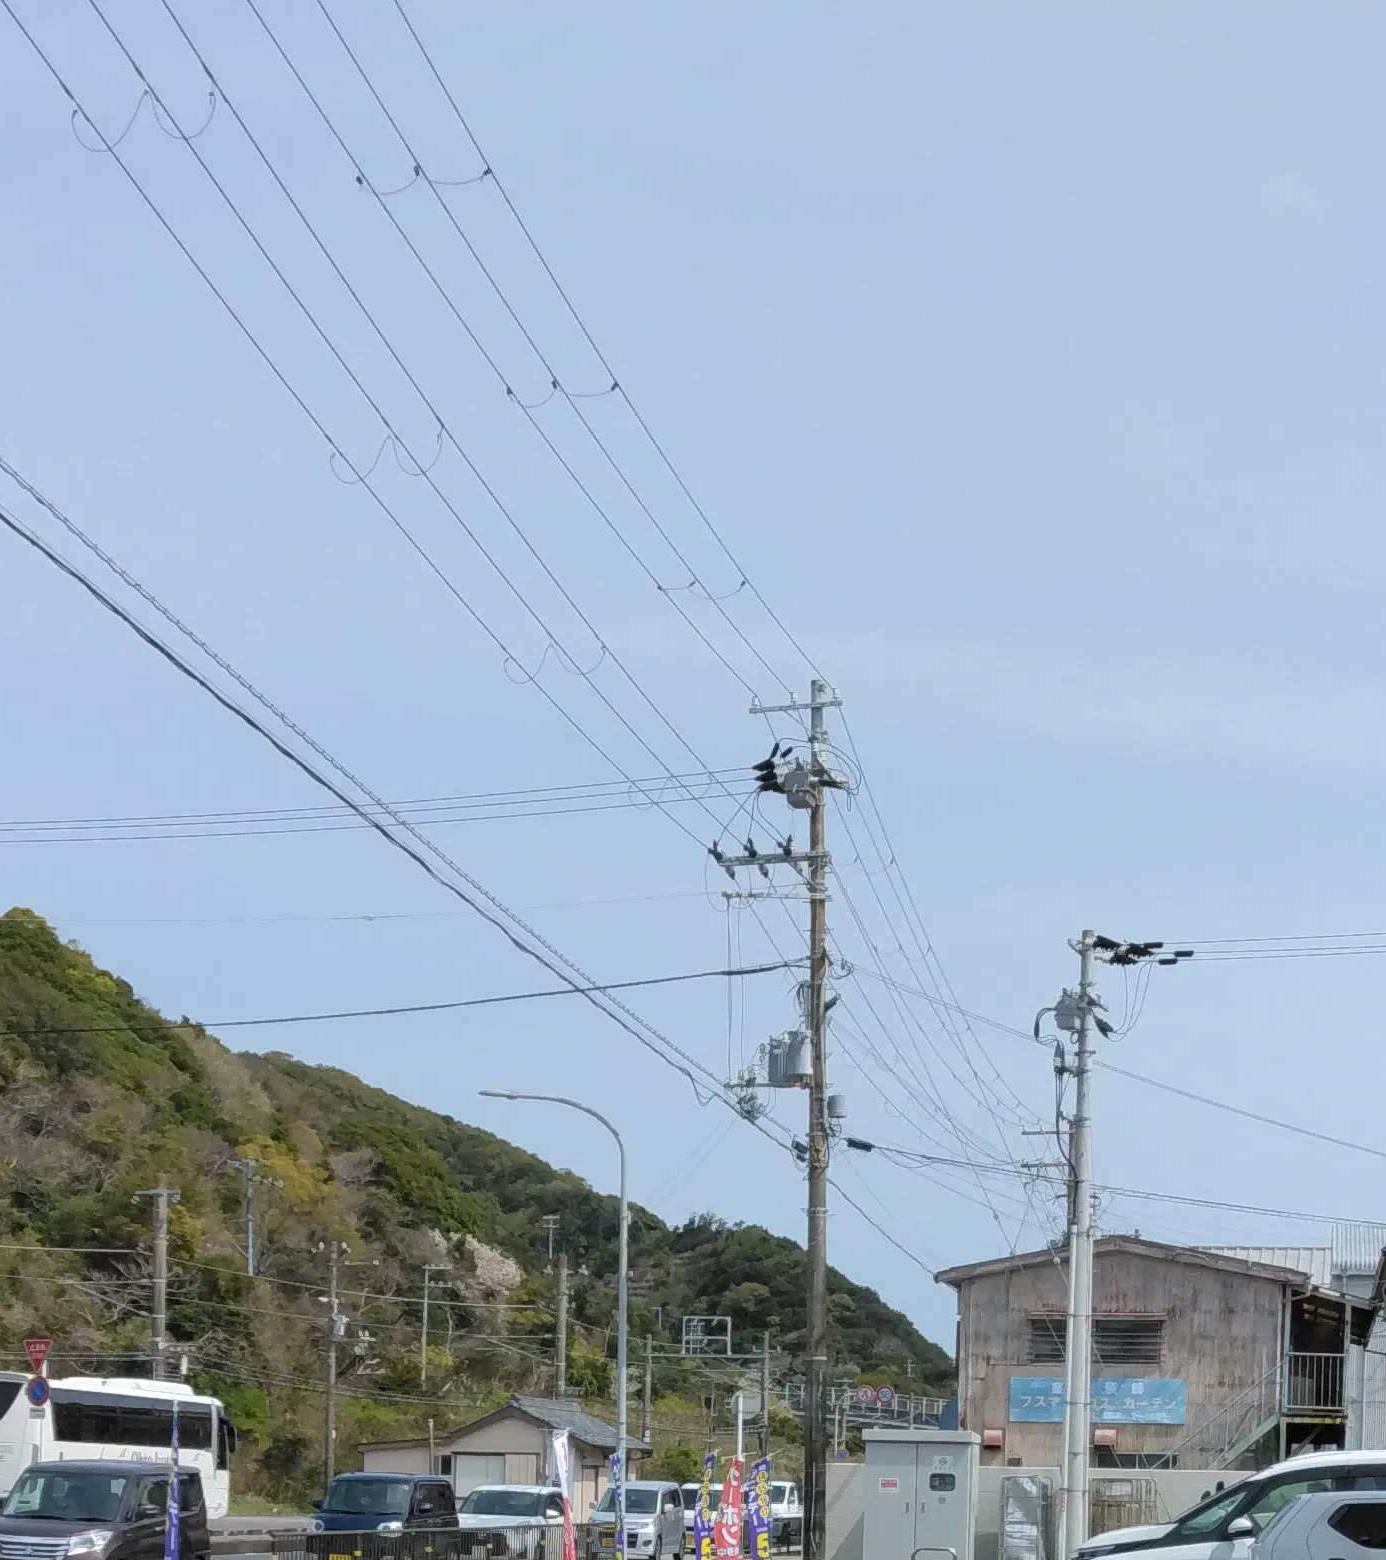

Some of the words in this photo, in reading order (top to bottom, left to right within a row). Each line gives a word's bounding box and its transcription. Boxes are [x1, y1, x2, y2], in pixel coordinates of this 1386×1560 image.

[1050, 1381, 1145, 1396] 室装飾
[1019, 1395, 1063, 1408] フスマ
